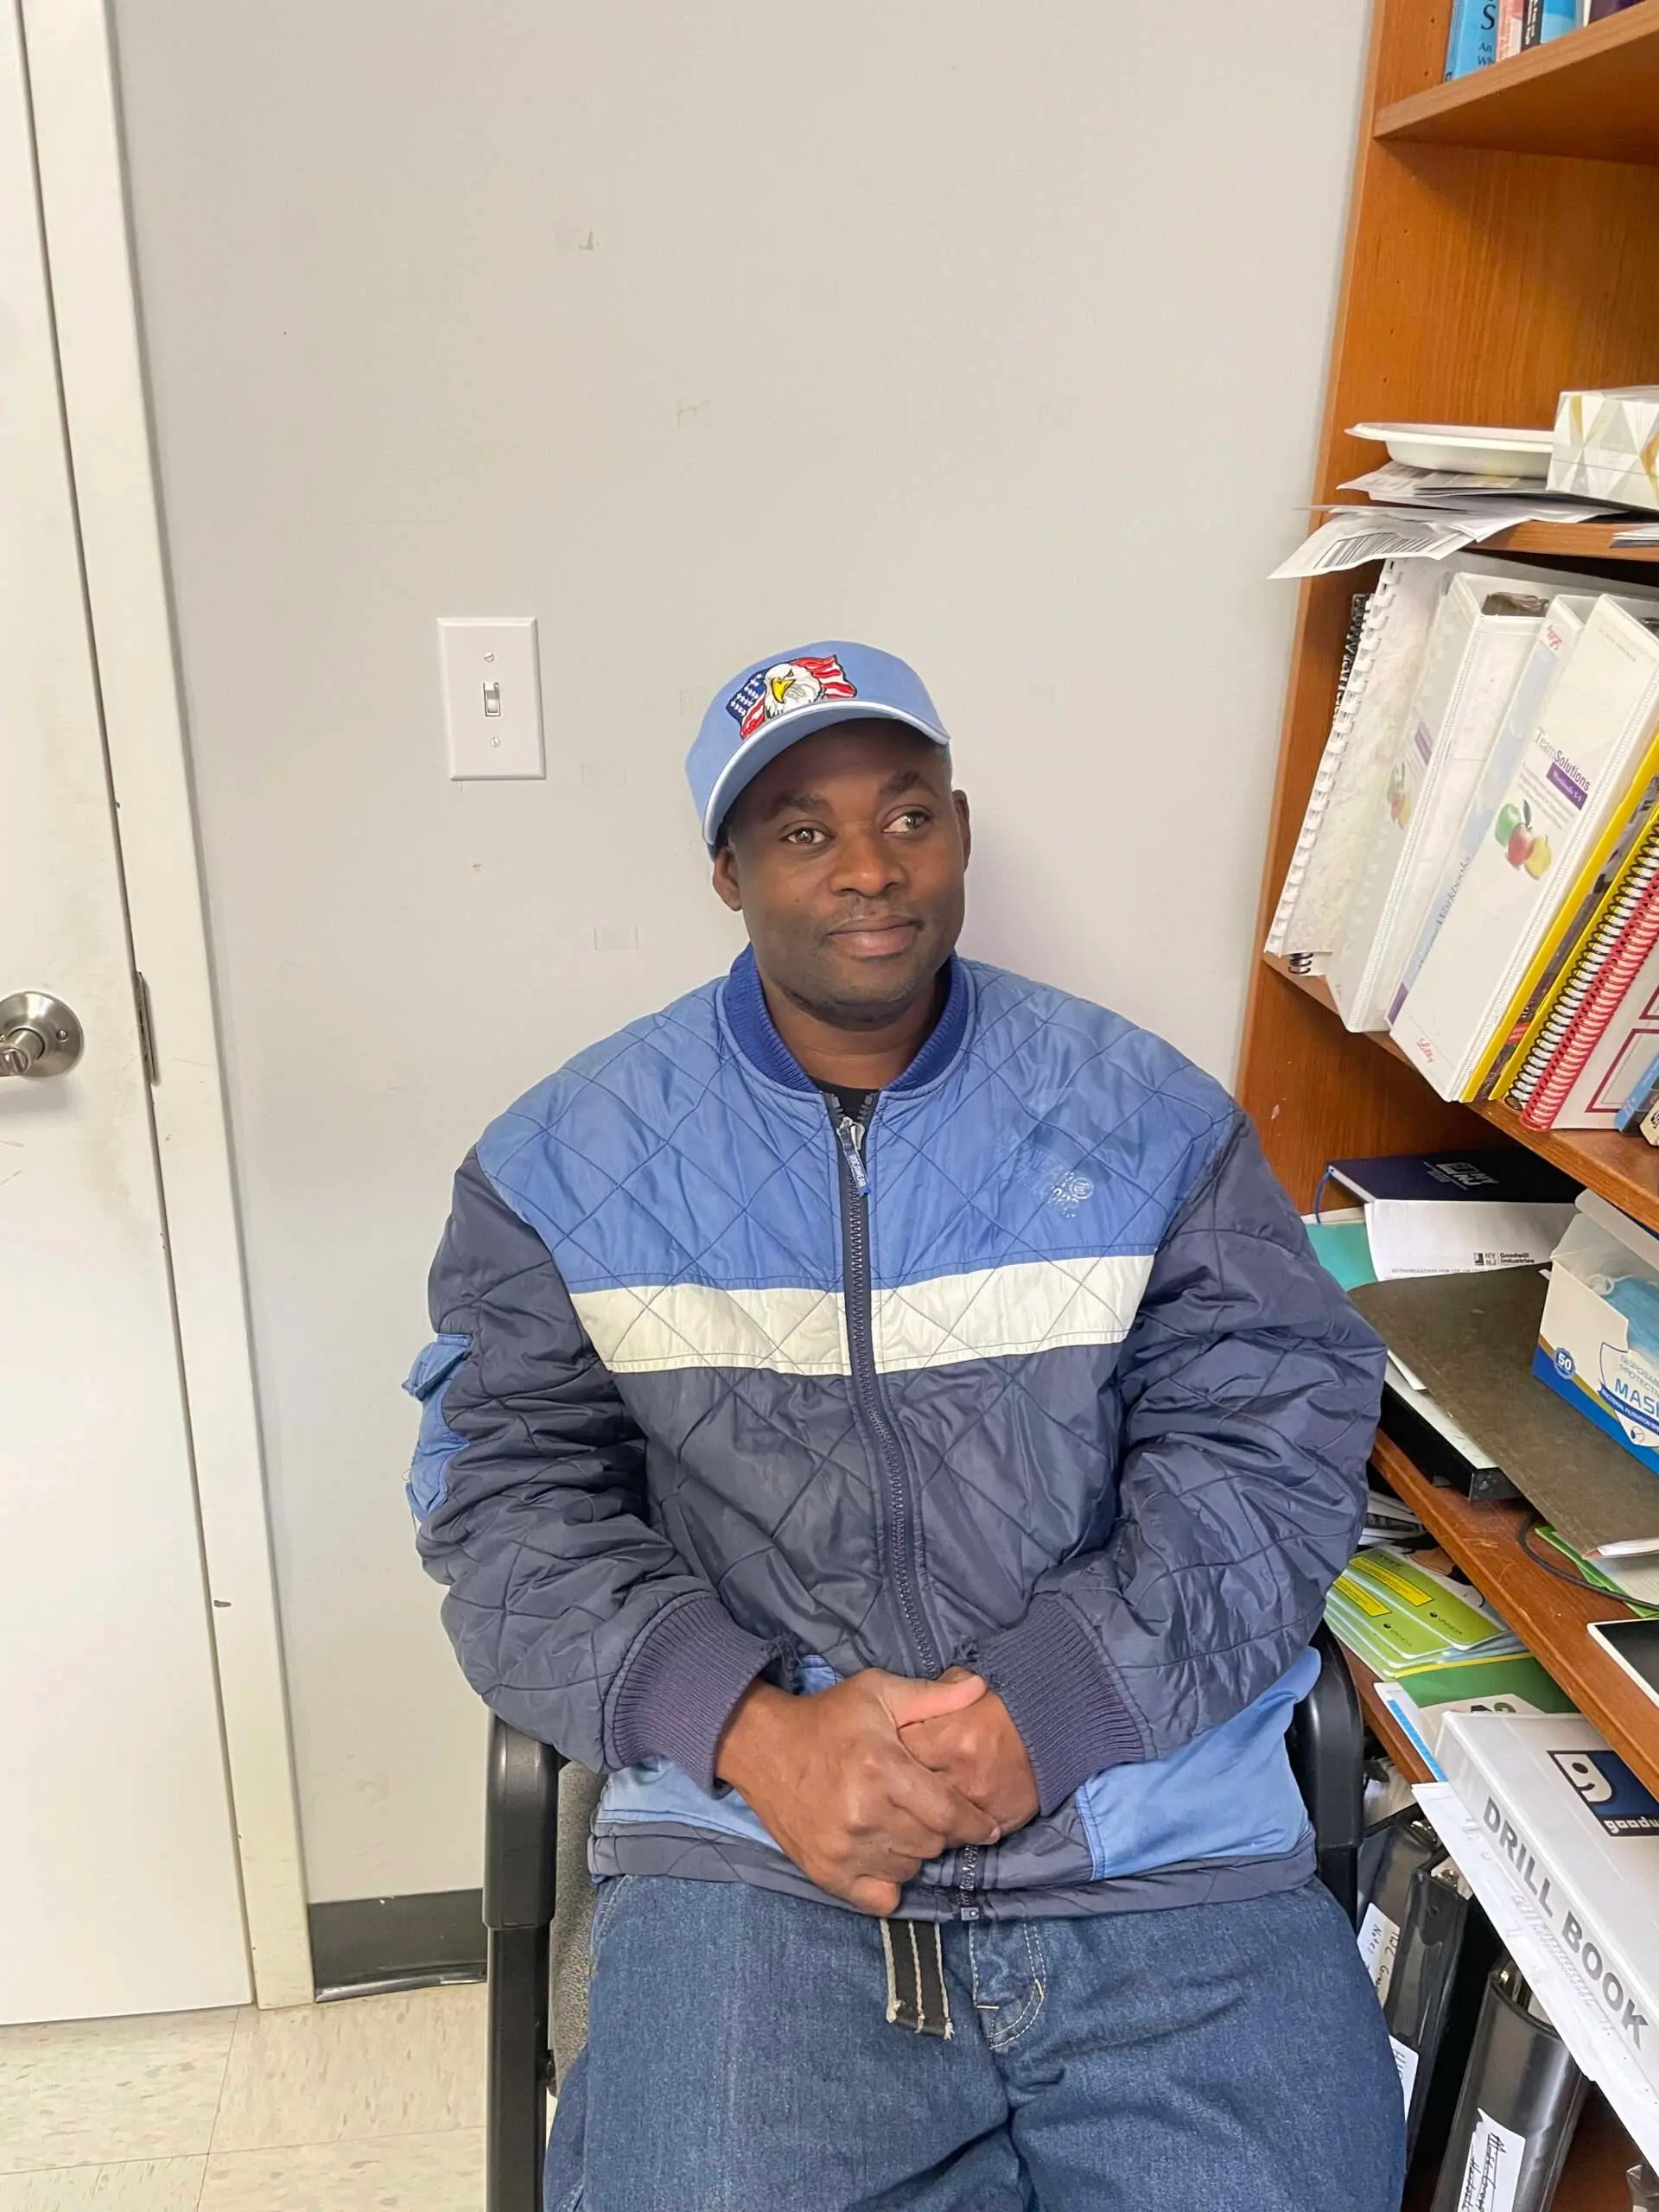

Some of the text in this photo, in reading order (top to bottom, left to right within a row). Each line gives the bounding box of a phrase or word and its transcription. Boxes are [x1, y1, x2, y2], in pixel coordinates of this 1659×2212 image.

[1557, 1351, 1573, 1371] 50
[1483, 1796, 1554, 1918] DRILL
[1561, 1909, 1649, 2051] BOOK
